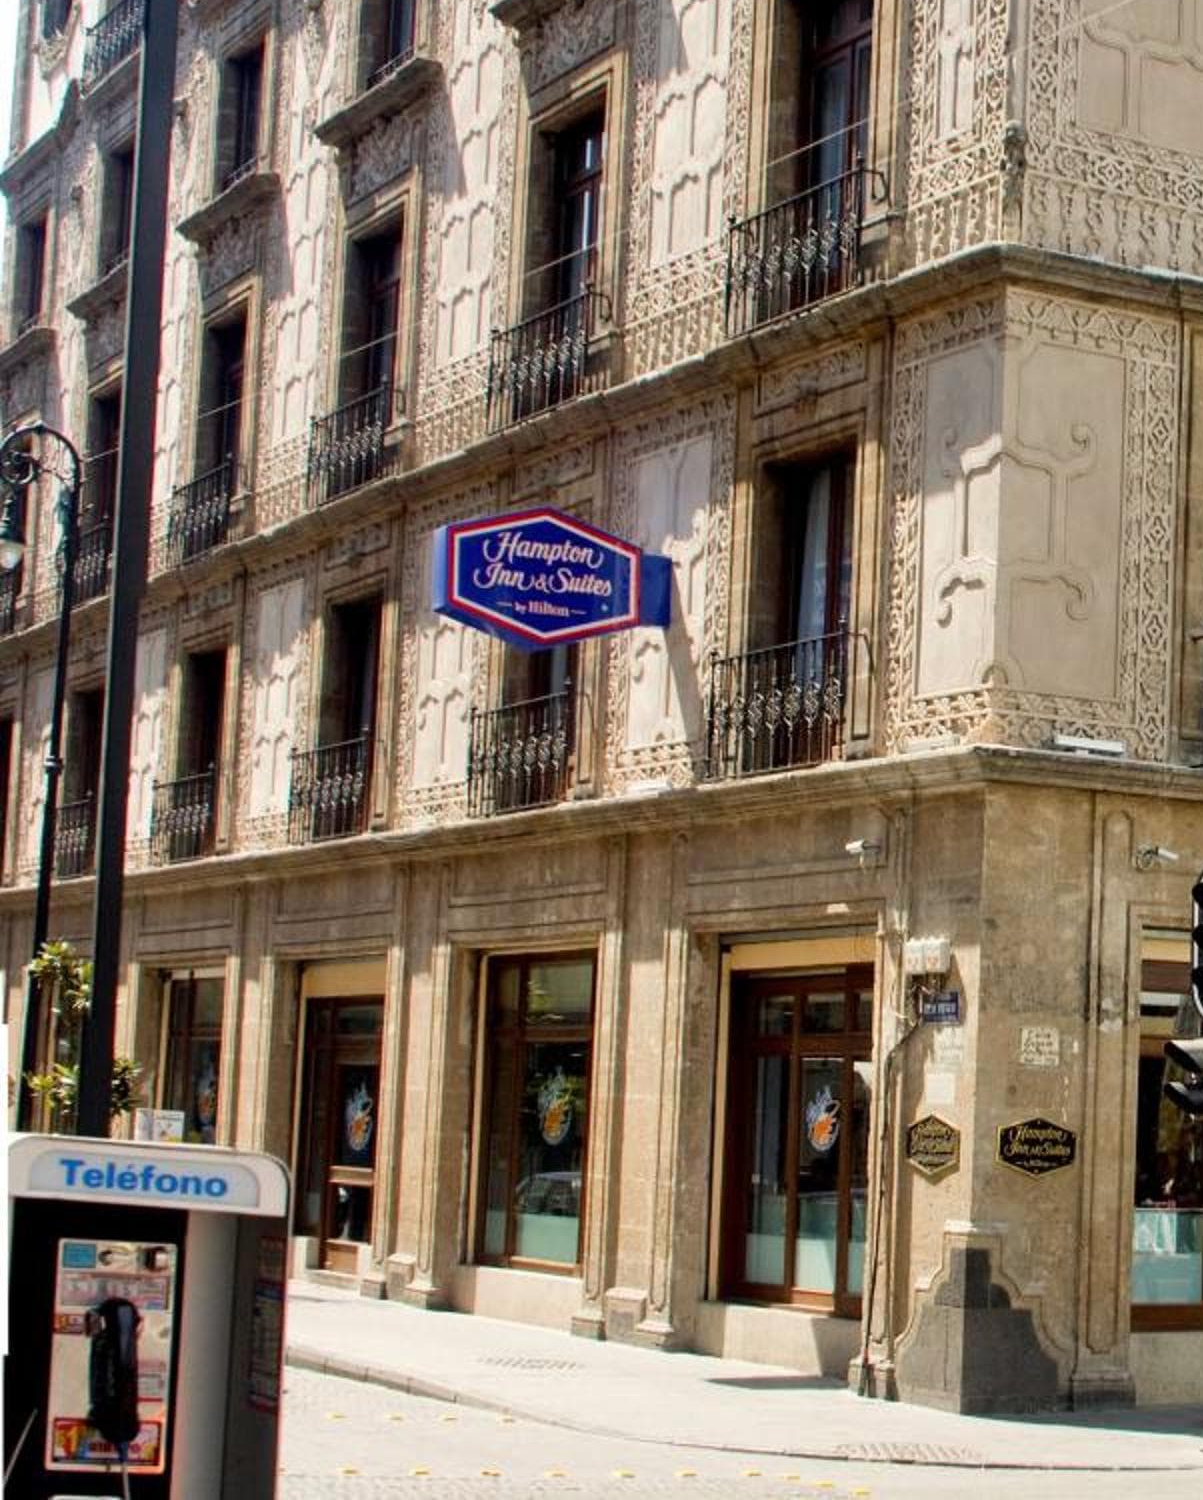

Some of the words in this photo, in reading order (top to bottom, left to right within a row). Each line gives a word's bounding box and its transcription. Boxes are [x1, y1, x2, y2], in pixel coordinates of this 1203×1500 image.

[483, 532, 604, 569] Hampton
[473, 562, 534, 590] Inn
[535, 574, 550, 593] &
[550, 567, 612, 596] Suites
[513, 602, 526, 614] by
[528, 601, 570, 617] Hilton
[59, 1159, 227, 1198] Teléfono
